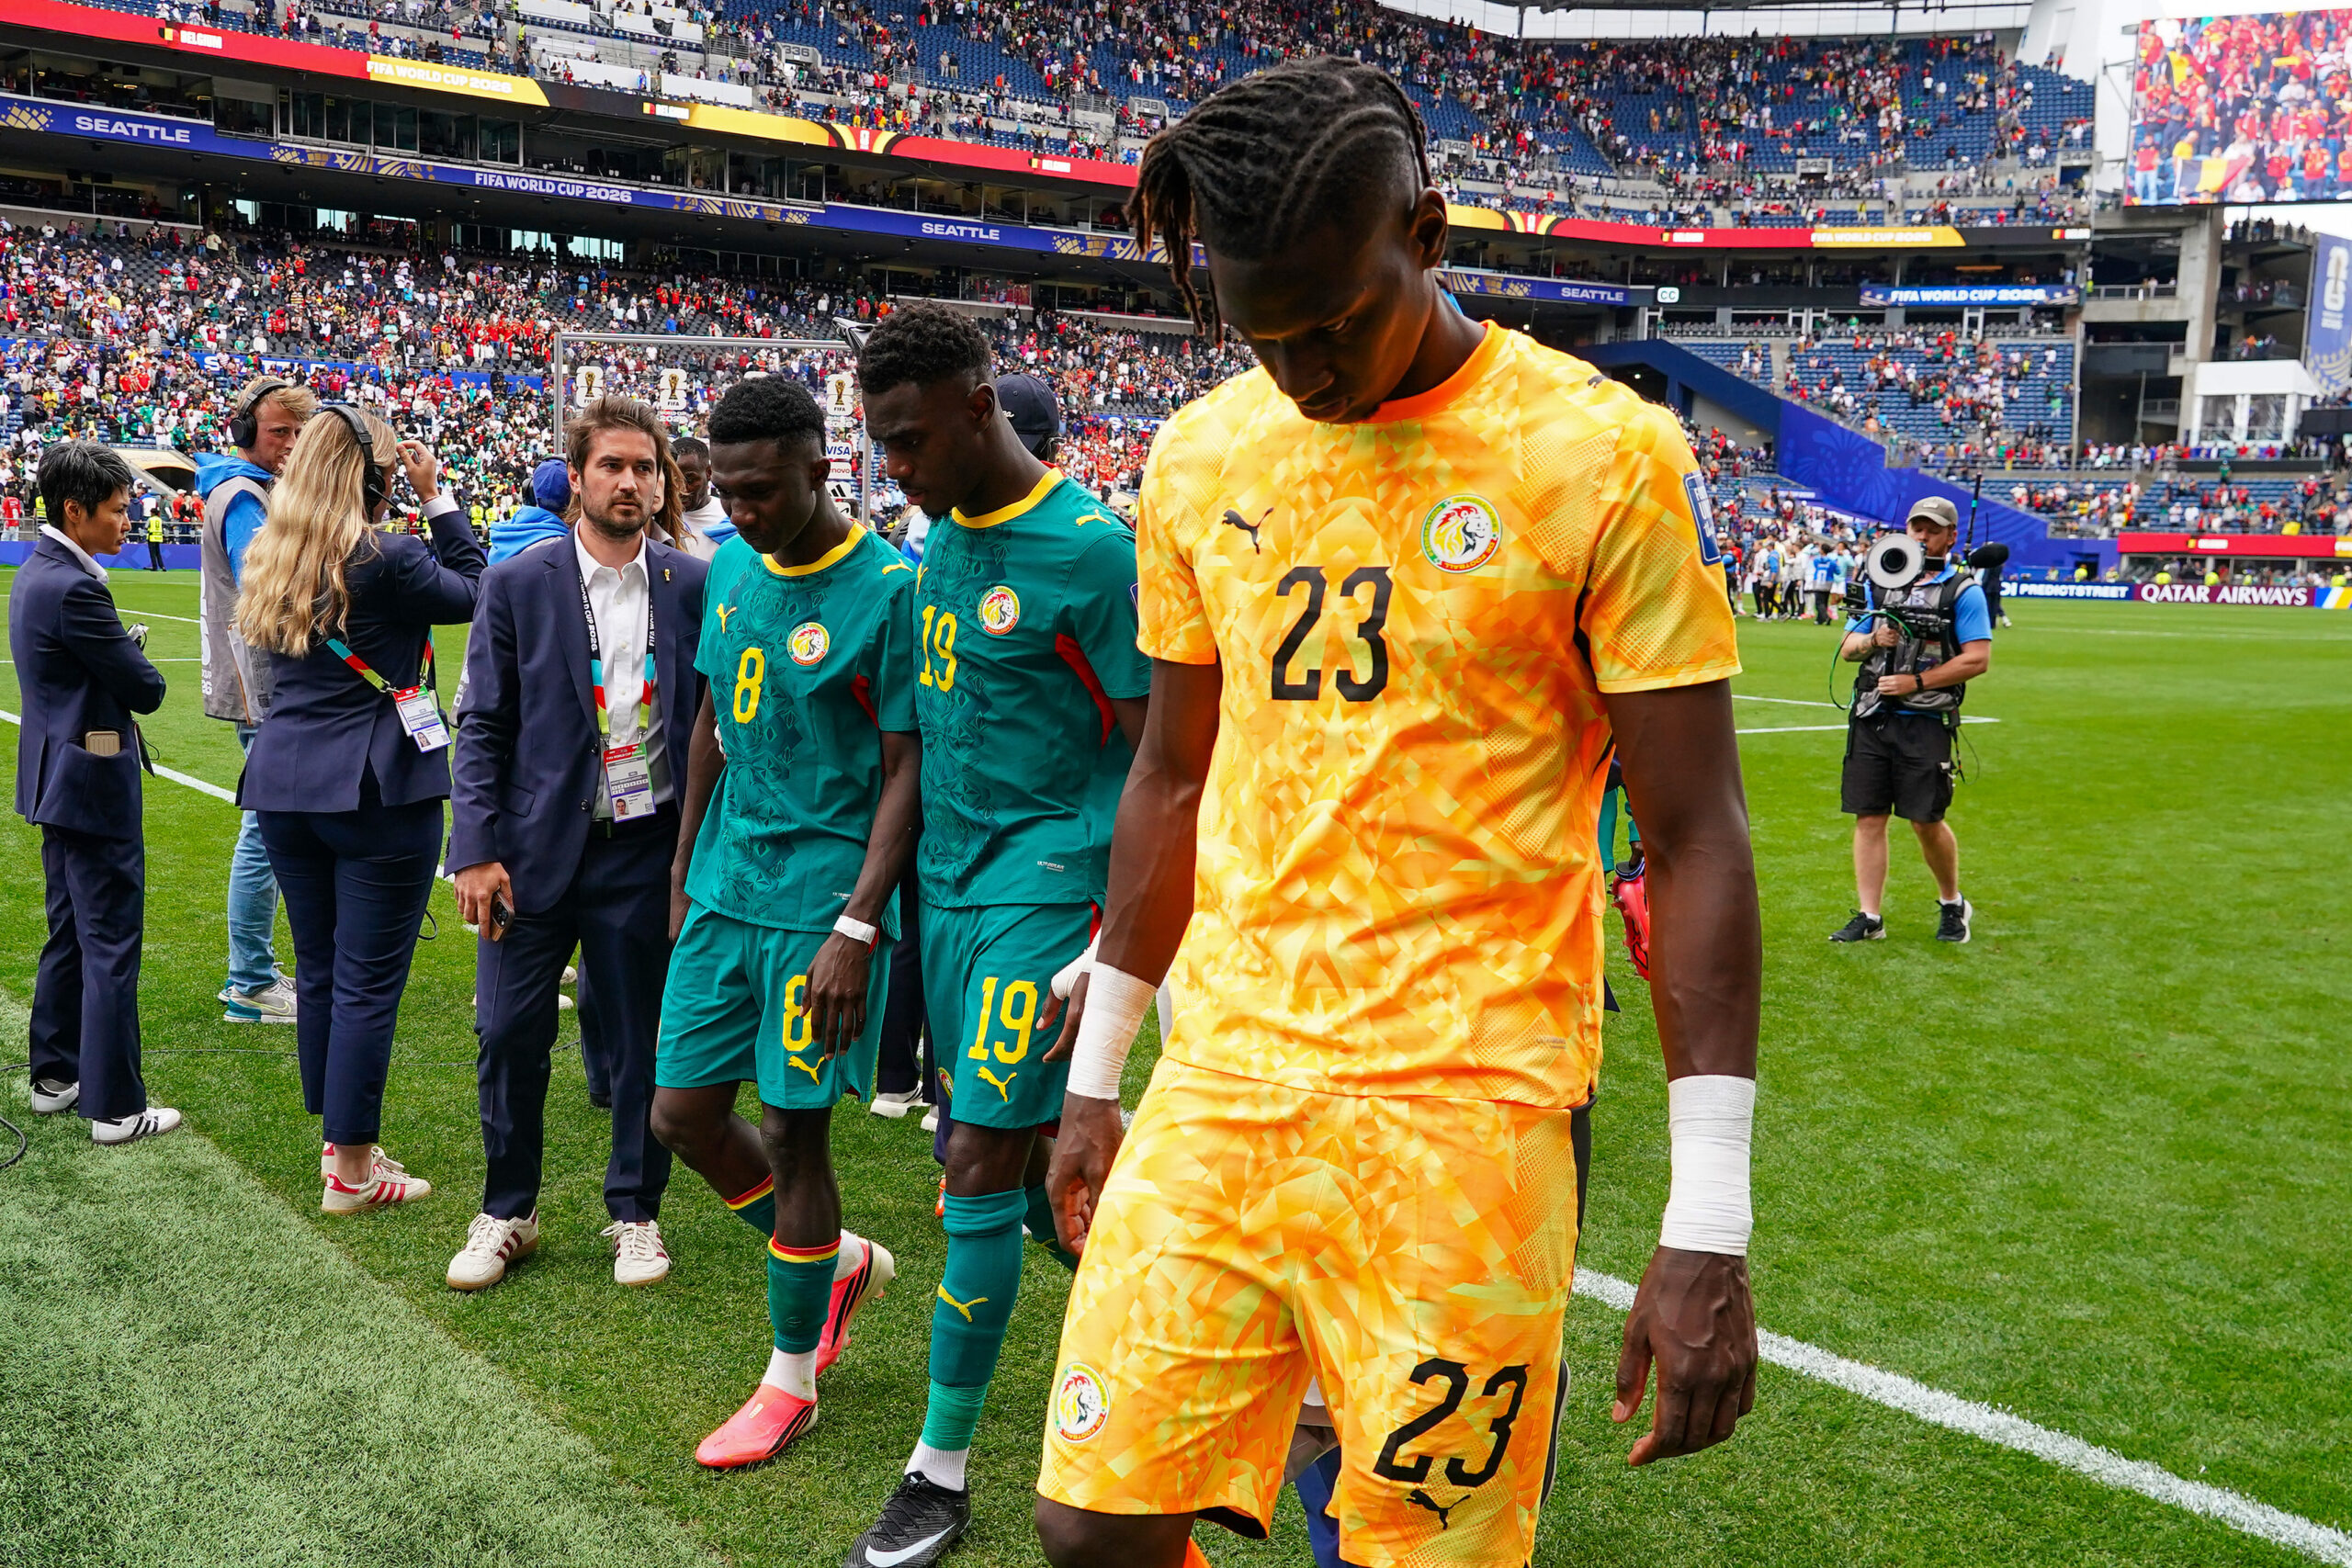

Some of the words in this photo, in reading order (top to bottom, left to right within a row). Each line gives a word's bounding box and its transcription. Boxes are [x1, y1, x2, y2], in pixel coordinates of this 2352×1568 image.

[783, 45, 810, 57] 336
[367, 61, 395, 76] FIFA
[395, 64, 442, 84] WORLD
[443, 73, 468, 86] CUP
[469, 77, 513, 94] 2026
[75, 116, 191, 143] SEATTLE
[475, 172, 505, 188] FIFA
[505, 175, 556, 193] WORLD
[557, 183, 584, 197] CUP
[585, 186, 632, 203] 2026
[922, 222, 1001, 241] SEATTLE
[1834, 231, 1872, 243] WORLD
[1872, 231, 1894, 243] CUP
[1561, 287, 1624, 302] SEATTLE
[1660, 290, 1676, 300] CC
[1890, 289, 1920, 302] FIFA
[1920, 289, 1969, 301] WORLD
[1969, 288, 1997, 301] CUP
[1997, 288, 2046, 300] 2026
[826, 446, 851, 456] VISA
[2141, 583, 2211, 604] QATAR
[2216, 585, 2308, 606] AIRWAYS
[588, 625, 598, 652] 2026
[1272, 567, 1394, 703] 23
[920, 604, 958, 694] 19
[732, 647, 765, 725] 8
[782, 975, 812, 1052] 8
[967, 976, 1038, 1065] 19
[1373, 1357, 1531, 1487] 23
